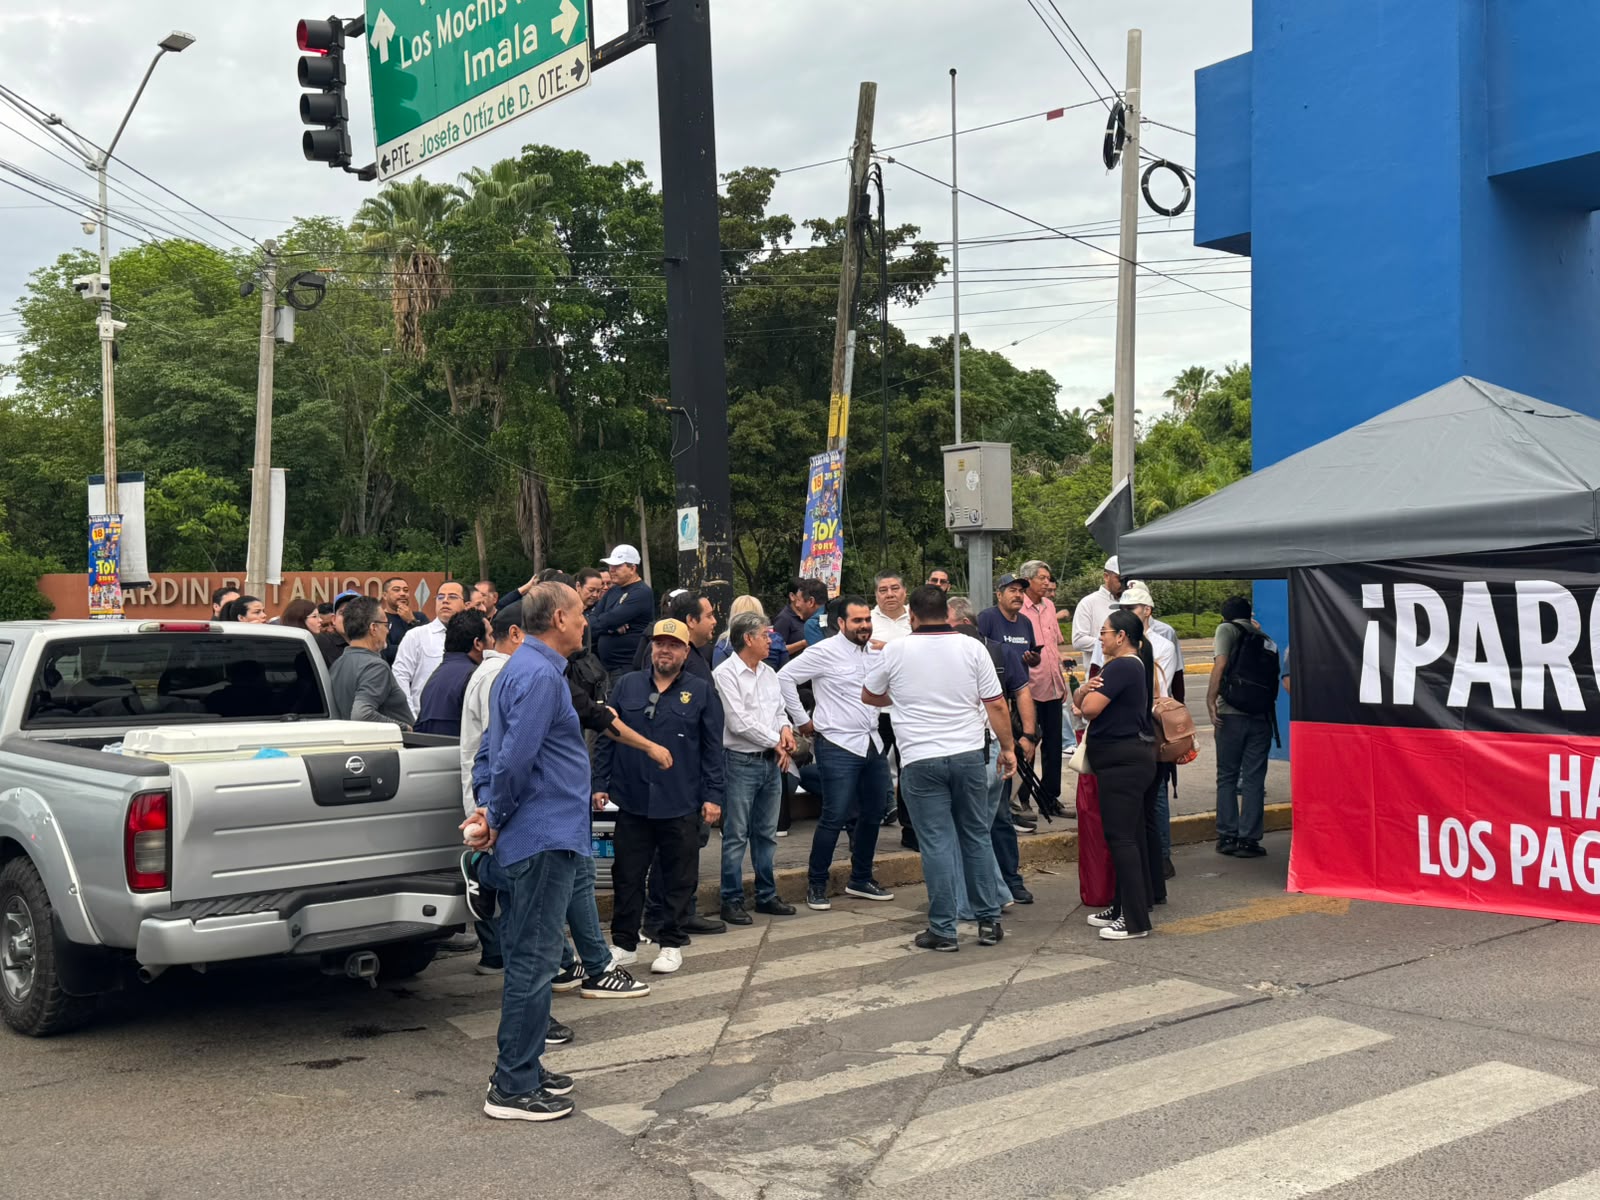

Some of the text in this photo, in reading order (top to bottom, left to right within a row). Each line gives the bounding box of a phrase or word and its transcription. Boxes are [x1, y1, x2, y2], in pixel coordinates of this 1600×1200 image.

[399, 30, 432, 70] Los
[463, 22, 538, 86] Imala
[391, 65, 568, 172] PTE. Josefa Ortíz de D. OTE.
[813, 518, 838, 542] TOY
[97, 560, 116, 574] TOY
[122, 577, 209, 605] ARDIN
[1417, 815, 1600, 895] LOS PAG
